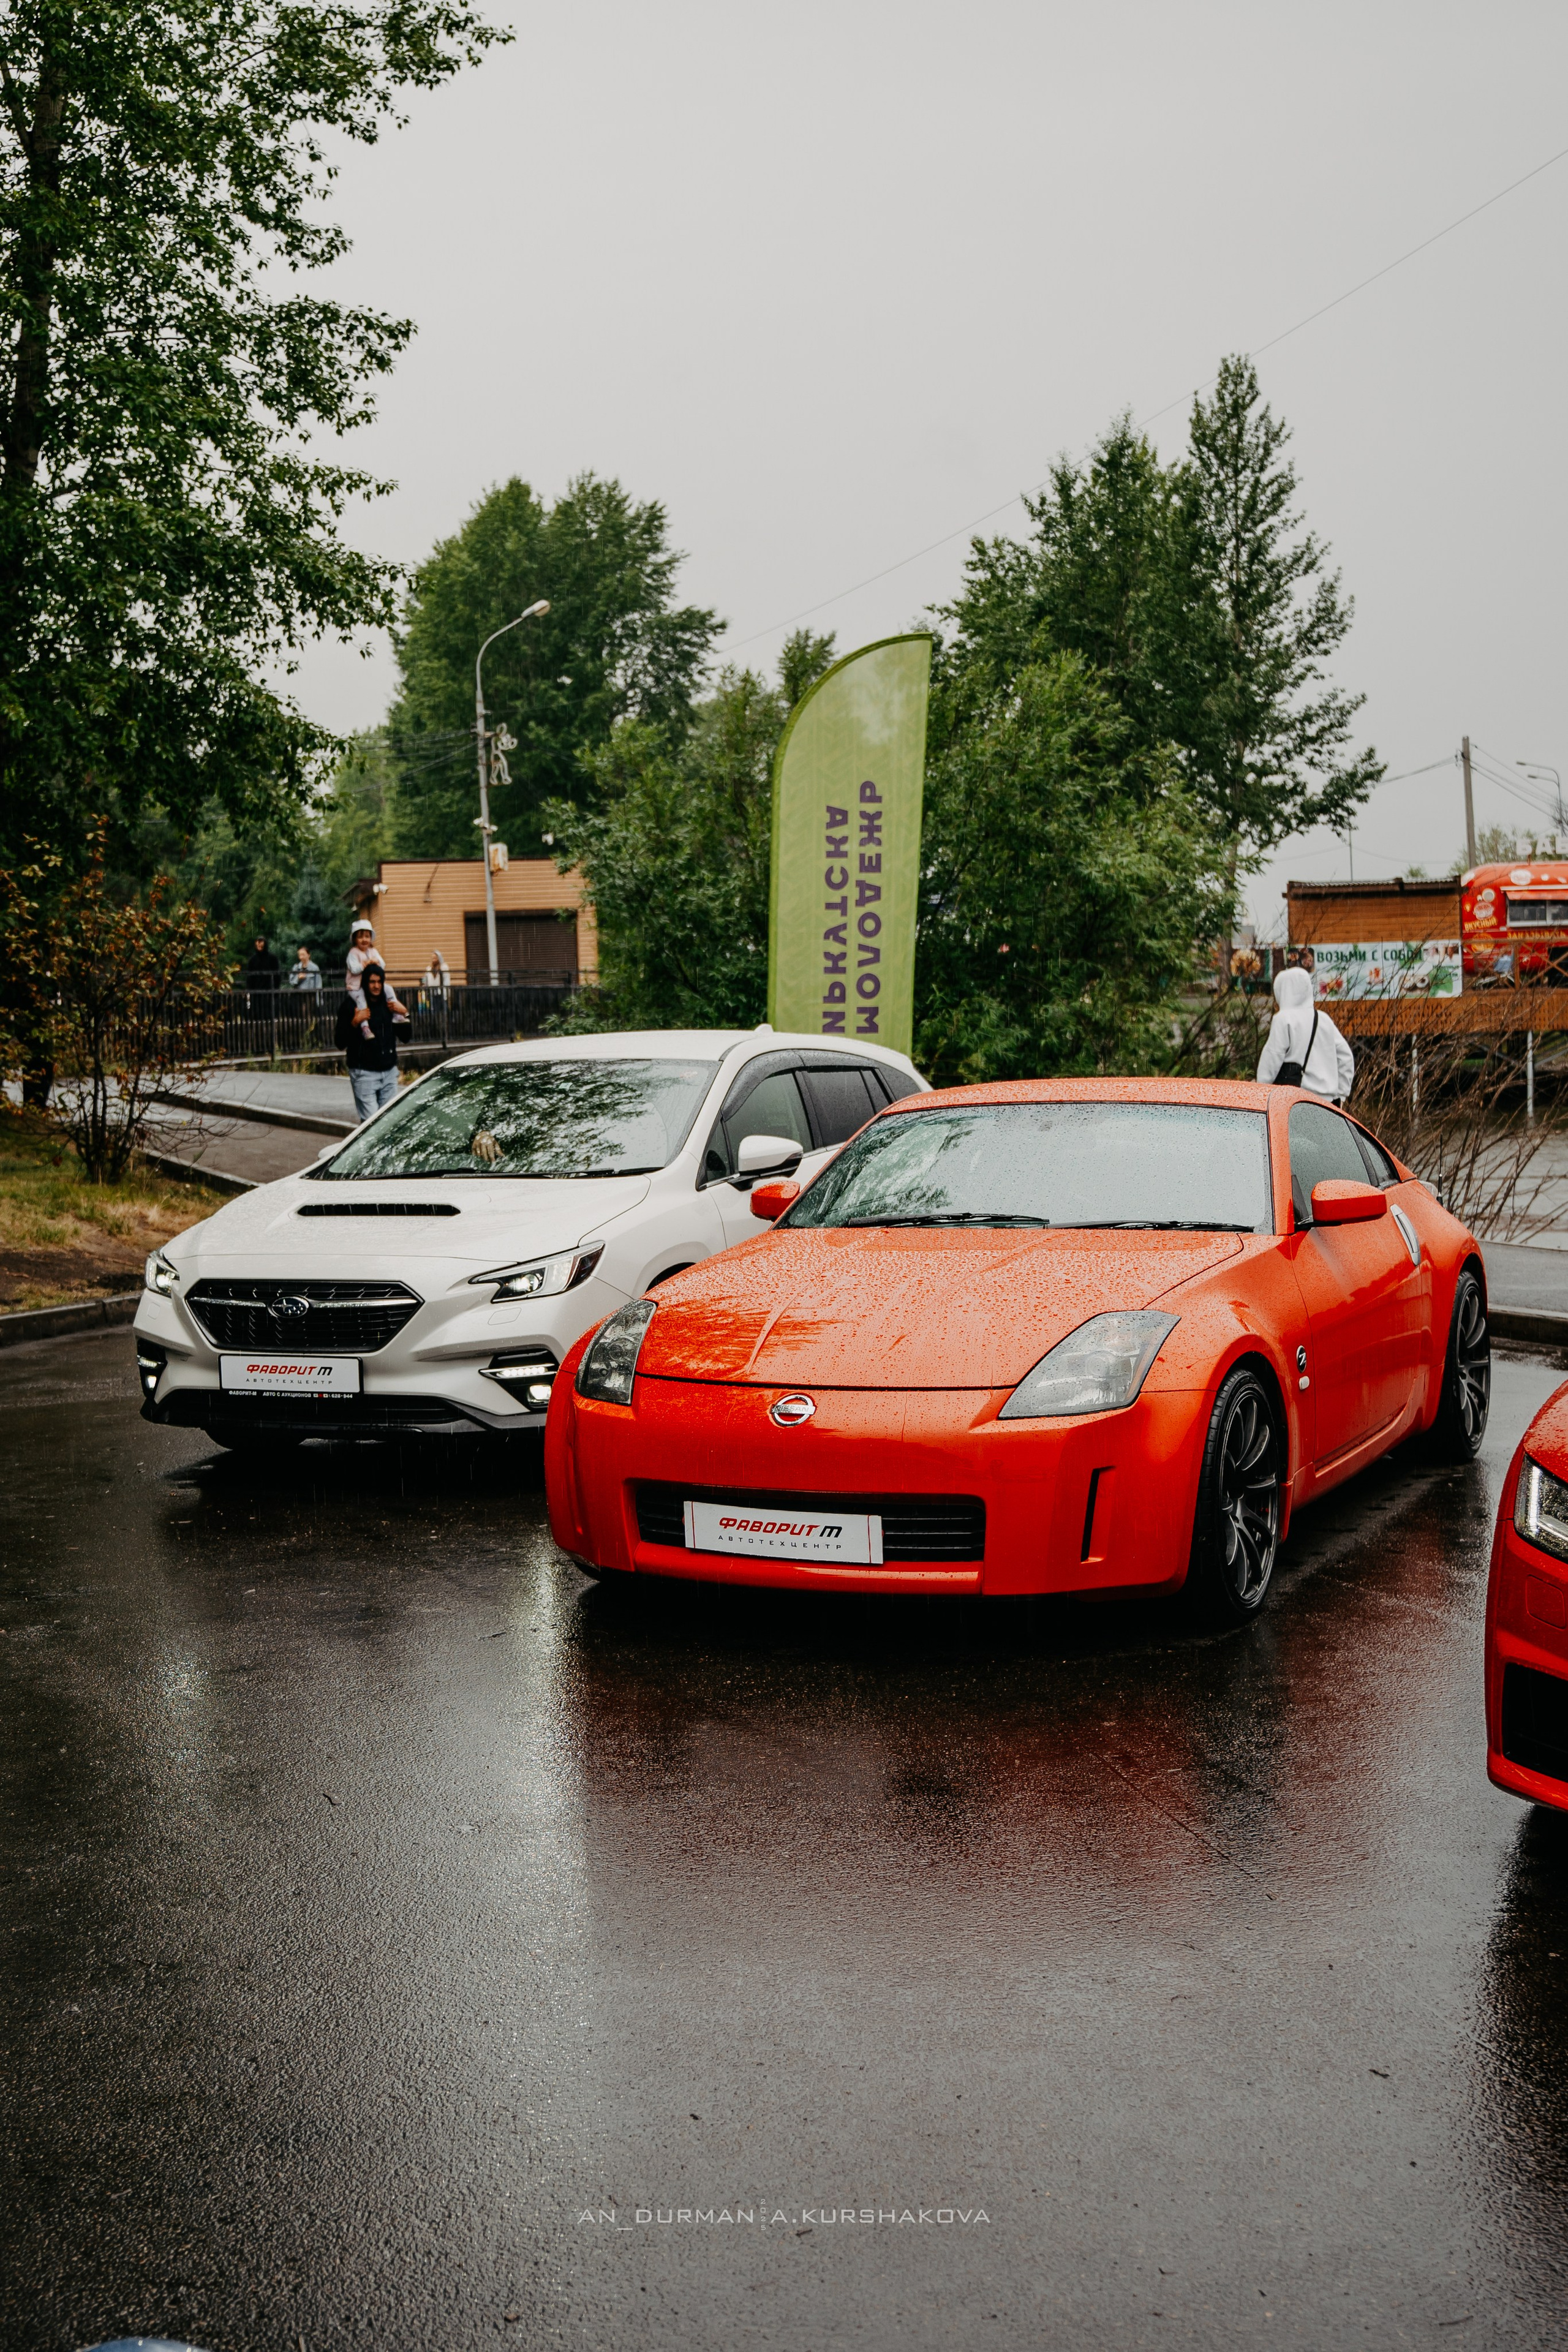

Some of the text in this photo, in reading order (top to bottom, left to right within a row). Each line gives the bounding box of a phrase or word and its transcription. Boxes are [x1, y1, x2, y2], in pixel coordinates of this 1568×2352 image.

[1317, 950, 1366, 963] ВОЗЬМИ
[1371, 949, 1378, 961] С
[246, 1364, 317, 1376] ФАВОРИТ
[775, 1404, 809, 1413] NISSAN
[719, 1517, 821, 1536] ФАВОРИТ
[718, 1535, 842, 1550] АВТОТЕХЦЕНТР
